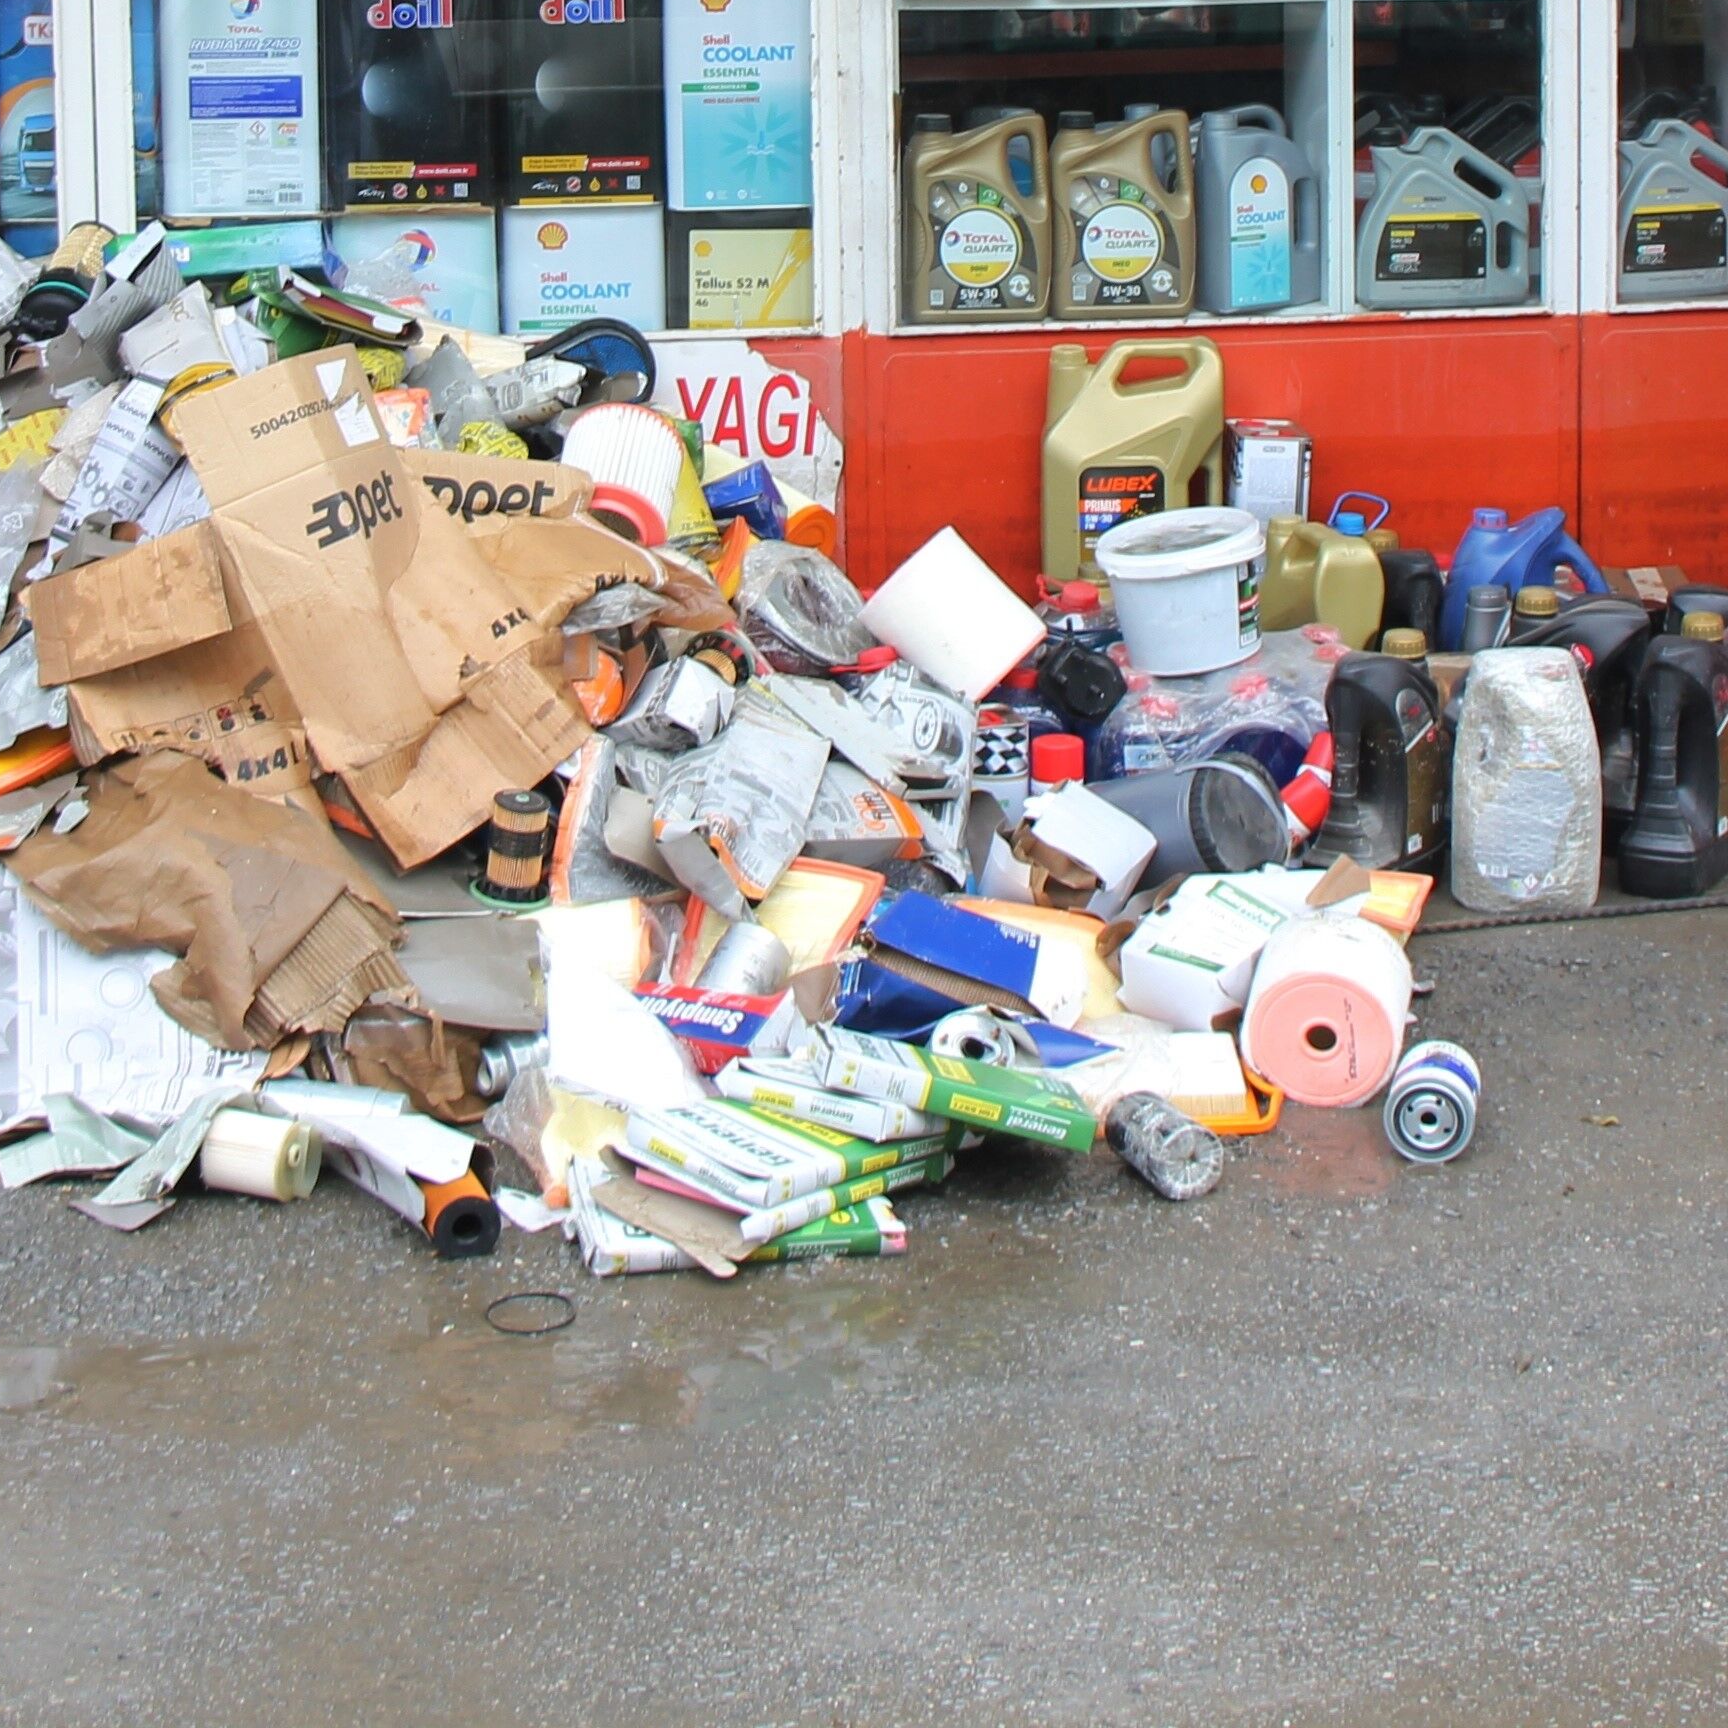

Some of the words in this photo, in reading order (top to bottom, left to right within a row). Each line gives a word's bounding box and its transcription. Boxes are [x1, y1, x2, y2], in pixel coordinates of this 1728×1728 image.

[227, 25, 263, 34] TOTAL
[189, 38, 235, 51] RUBIA
[236, 38, 258, 51] TIR
[260, 37, 301, 51] 7400
[702, 45, 795, 63] COOLANT
[702, 67, 761, 78] ESSENTIAL
[1236, 210, 1286, 224] COOLANT
[962, 233, 1008, 244] TOTAL
[1105, 228, 1150, 239] TOTAL
[963, 244, 1015, 255] QUARTZ
[1105, 239, 1157, 250] QUARTZ
[695, 277, 733, 289] Tellus
[736, 277, 753, 289] S2
[757, 277, 770, 289] M
[540, 282, 632, 301] COOLANT
[959, 288, 999, 300] 5W-30
[1102, 285, 1142, 298] 5W-30
[695, 298, 709, 308] 46
[540, 304, 598, 315] ESSENTIAL
[1085, 472, 1158, 492] LUBEX
[1084, 498, 1122, 513] PRIMUS
